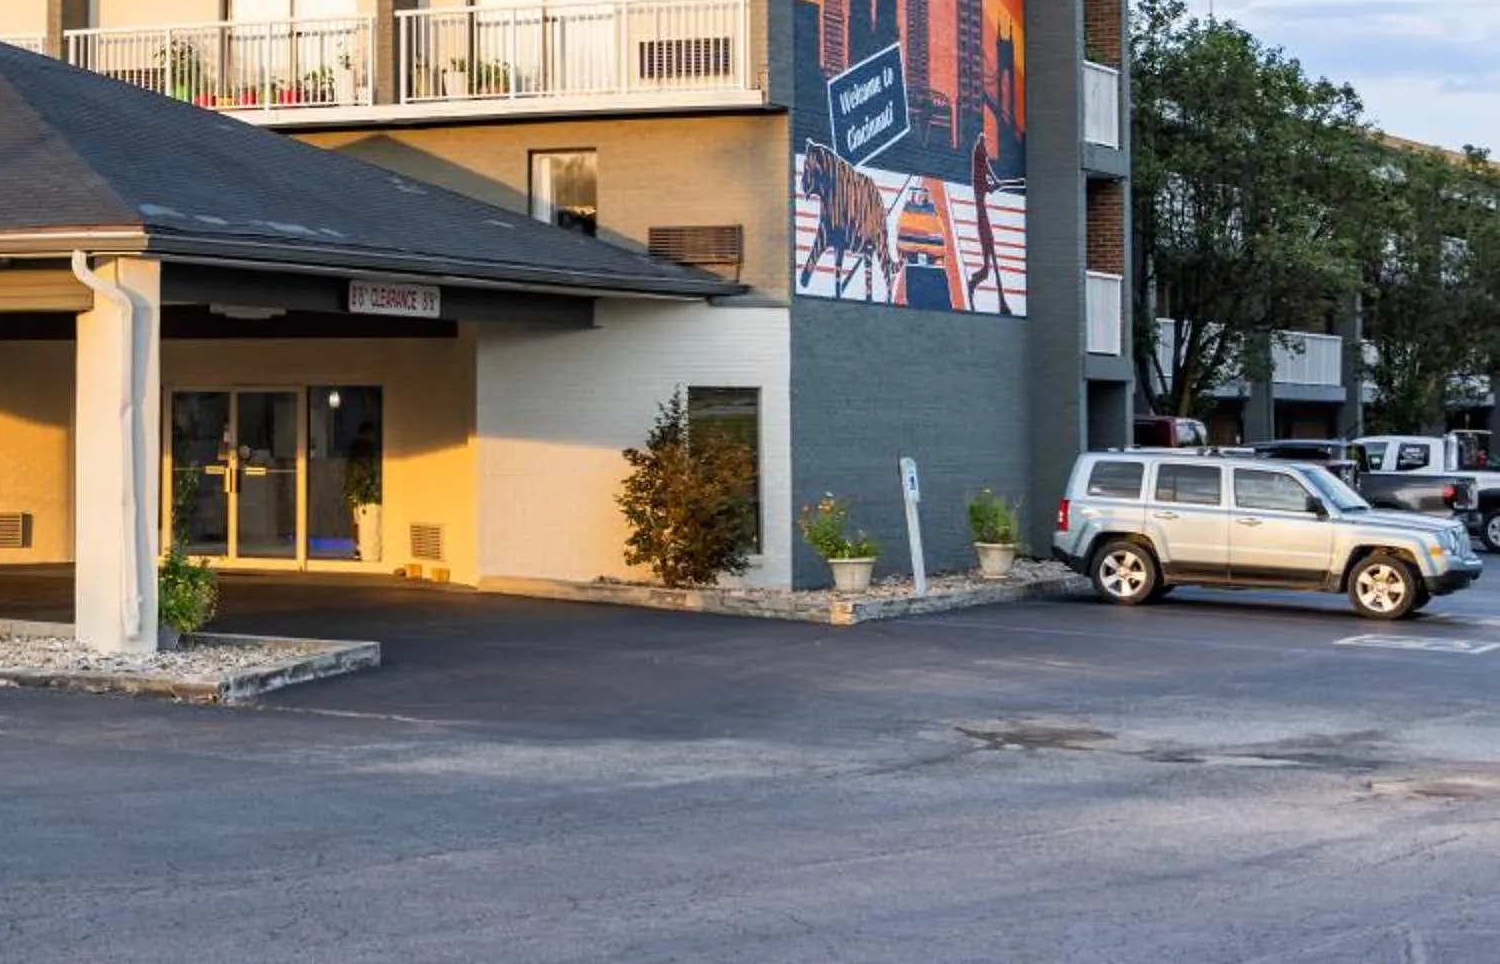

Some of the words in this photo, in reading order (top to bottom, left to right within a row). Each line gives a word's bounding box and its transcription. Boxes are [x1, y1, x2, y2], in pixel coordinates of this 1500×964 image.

[839, 75, 882, 115] Welcome
[883, 66, 894, 88] to
[847, 100, 894, 153] Cincinnati
[371, 286, 417, 311] CLEARANCE
